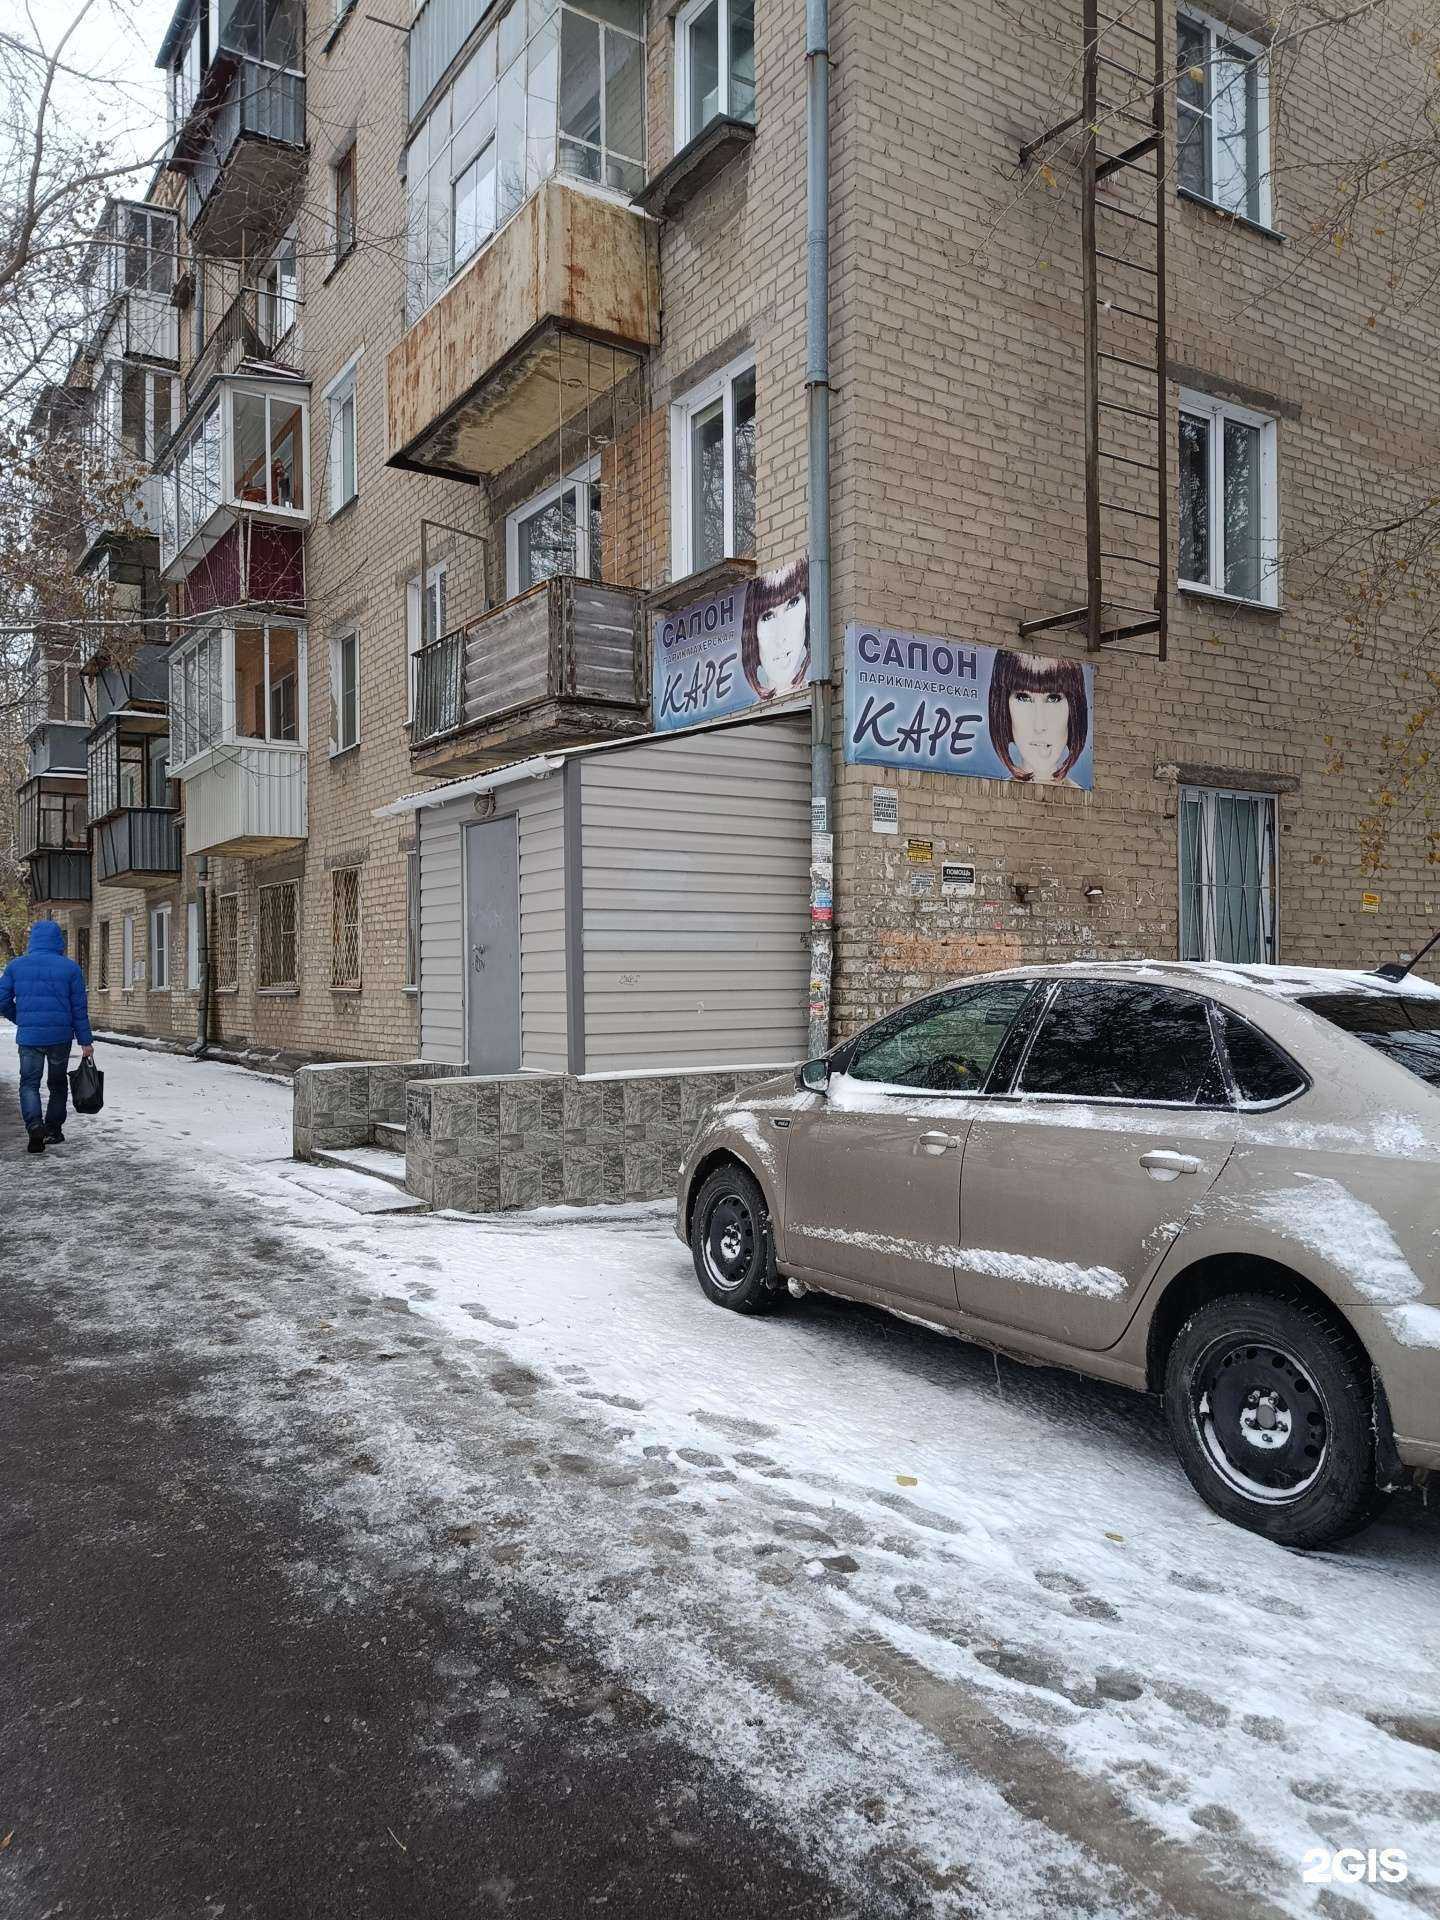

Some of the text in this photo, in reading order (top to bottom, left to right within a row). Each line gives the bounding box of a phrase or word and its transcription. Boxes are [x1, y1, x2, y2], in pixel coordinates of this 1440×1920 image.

[663, 630, 736, 665] ПАРИКМАХЕРСКАЯ
[660, 652, 738, 718] КАРЕ
[859, 671, 978, 699] ПАРИКМАХЕРСКАЯ
[852, 695, 983, 757] КАРЕ
[946, 868, 971, 877] ПОМОЩЬ
